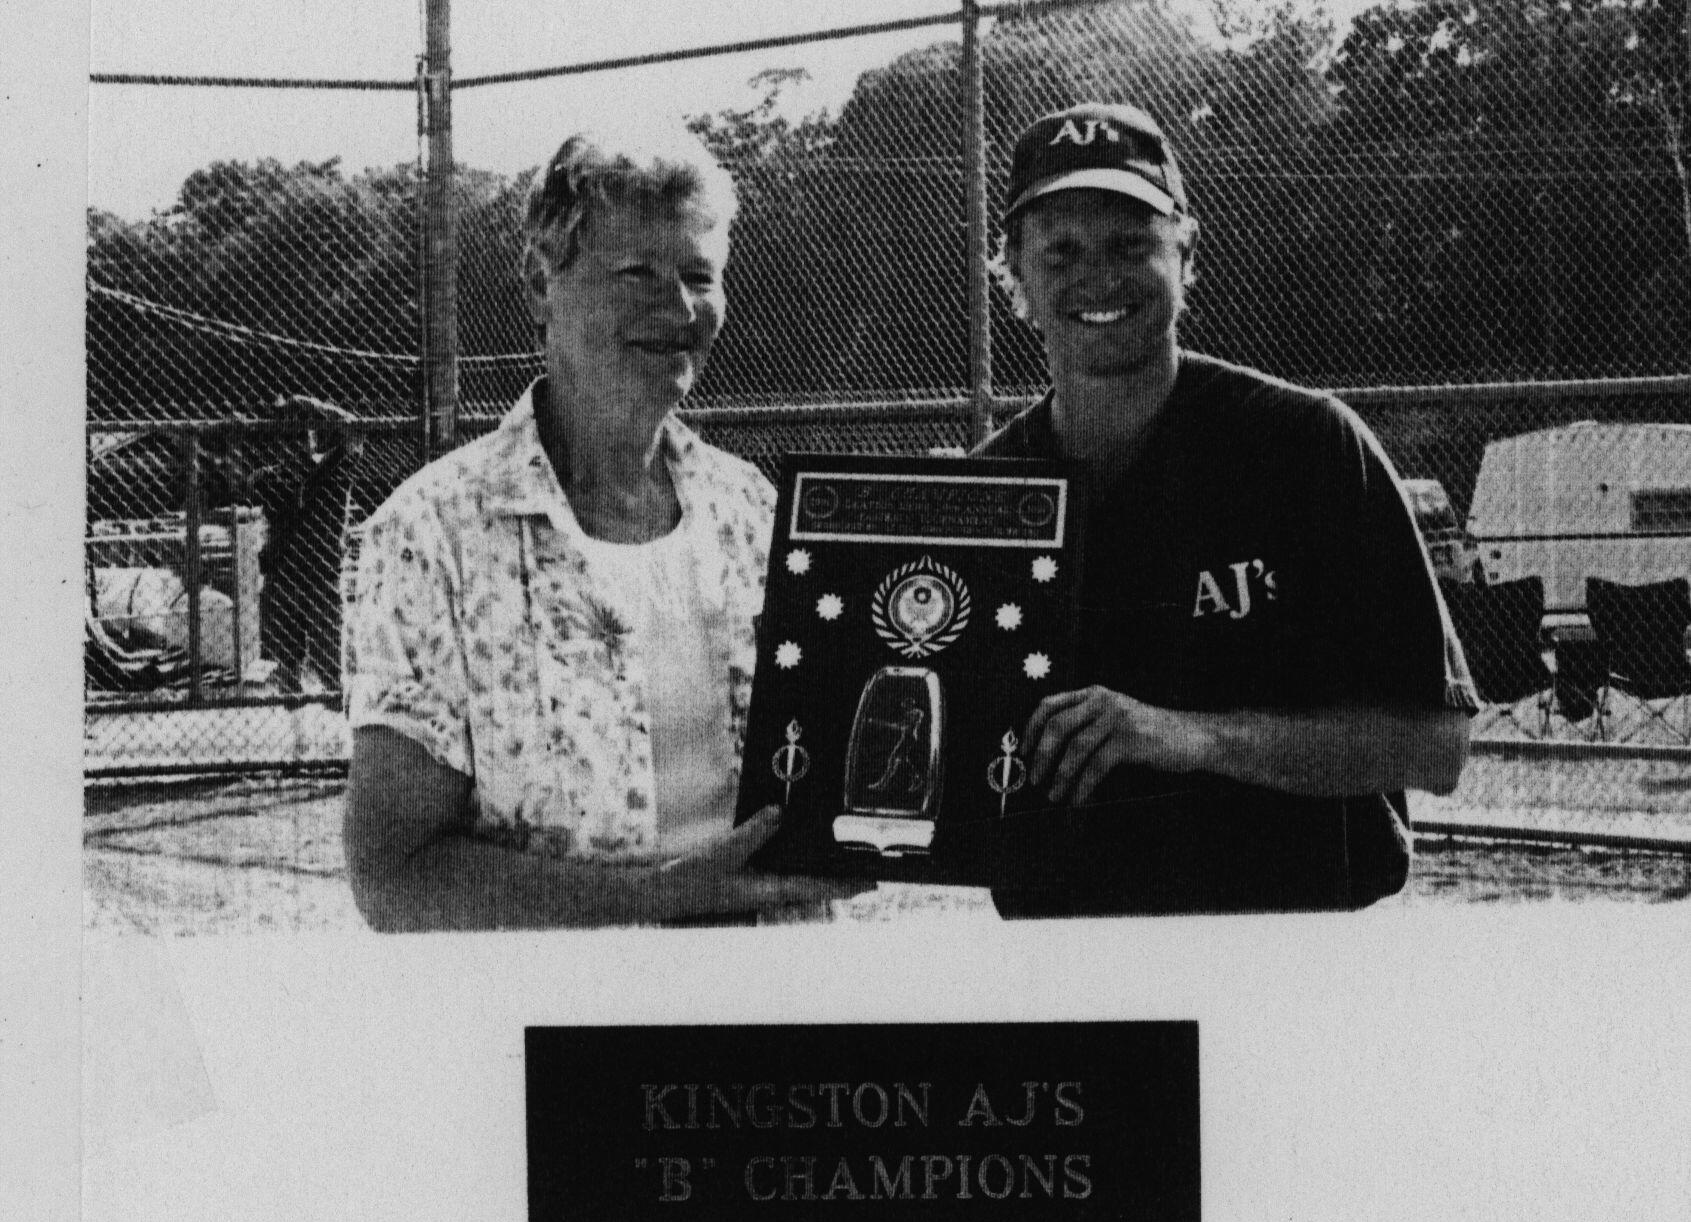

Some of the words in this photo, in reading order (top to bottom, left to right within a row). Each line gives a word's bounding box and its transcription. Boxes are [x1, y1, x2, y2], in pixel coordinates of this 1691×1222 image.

[641, 1081, 932, 1131] KINGSTON
[958, 1081, 1085, 1127] AJ'S
[634, 1156, 717, 1202] "B"
[744, 1153, 1093, 1201] CHAMPIONS
